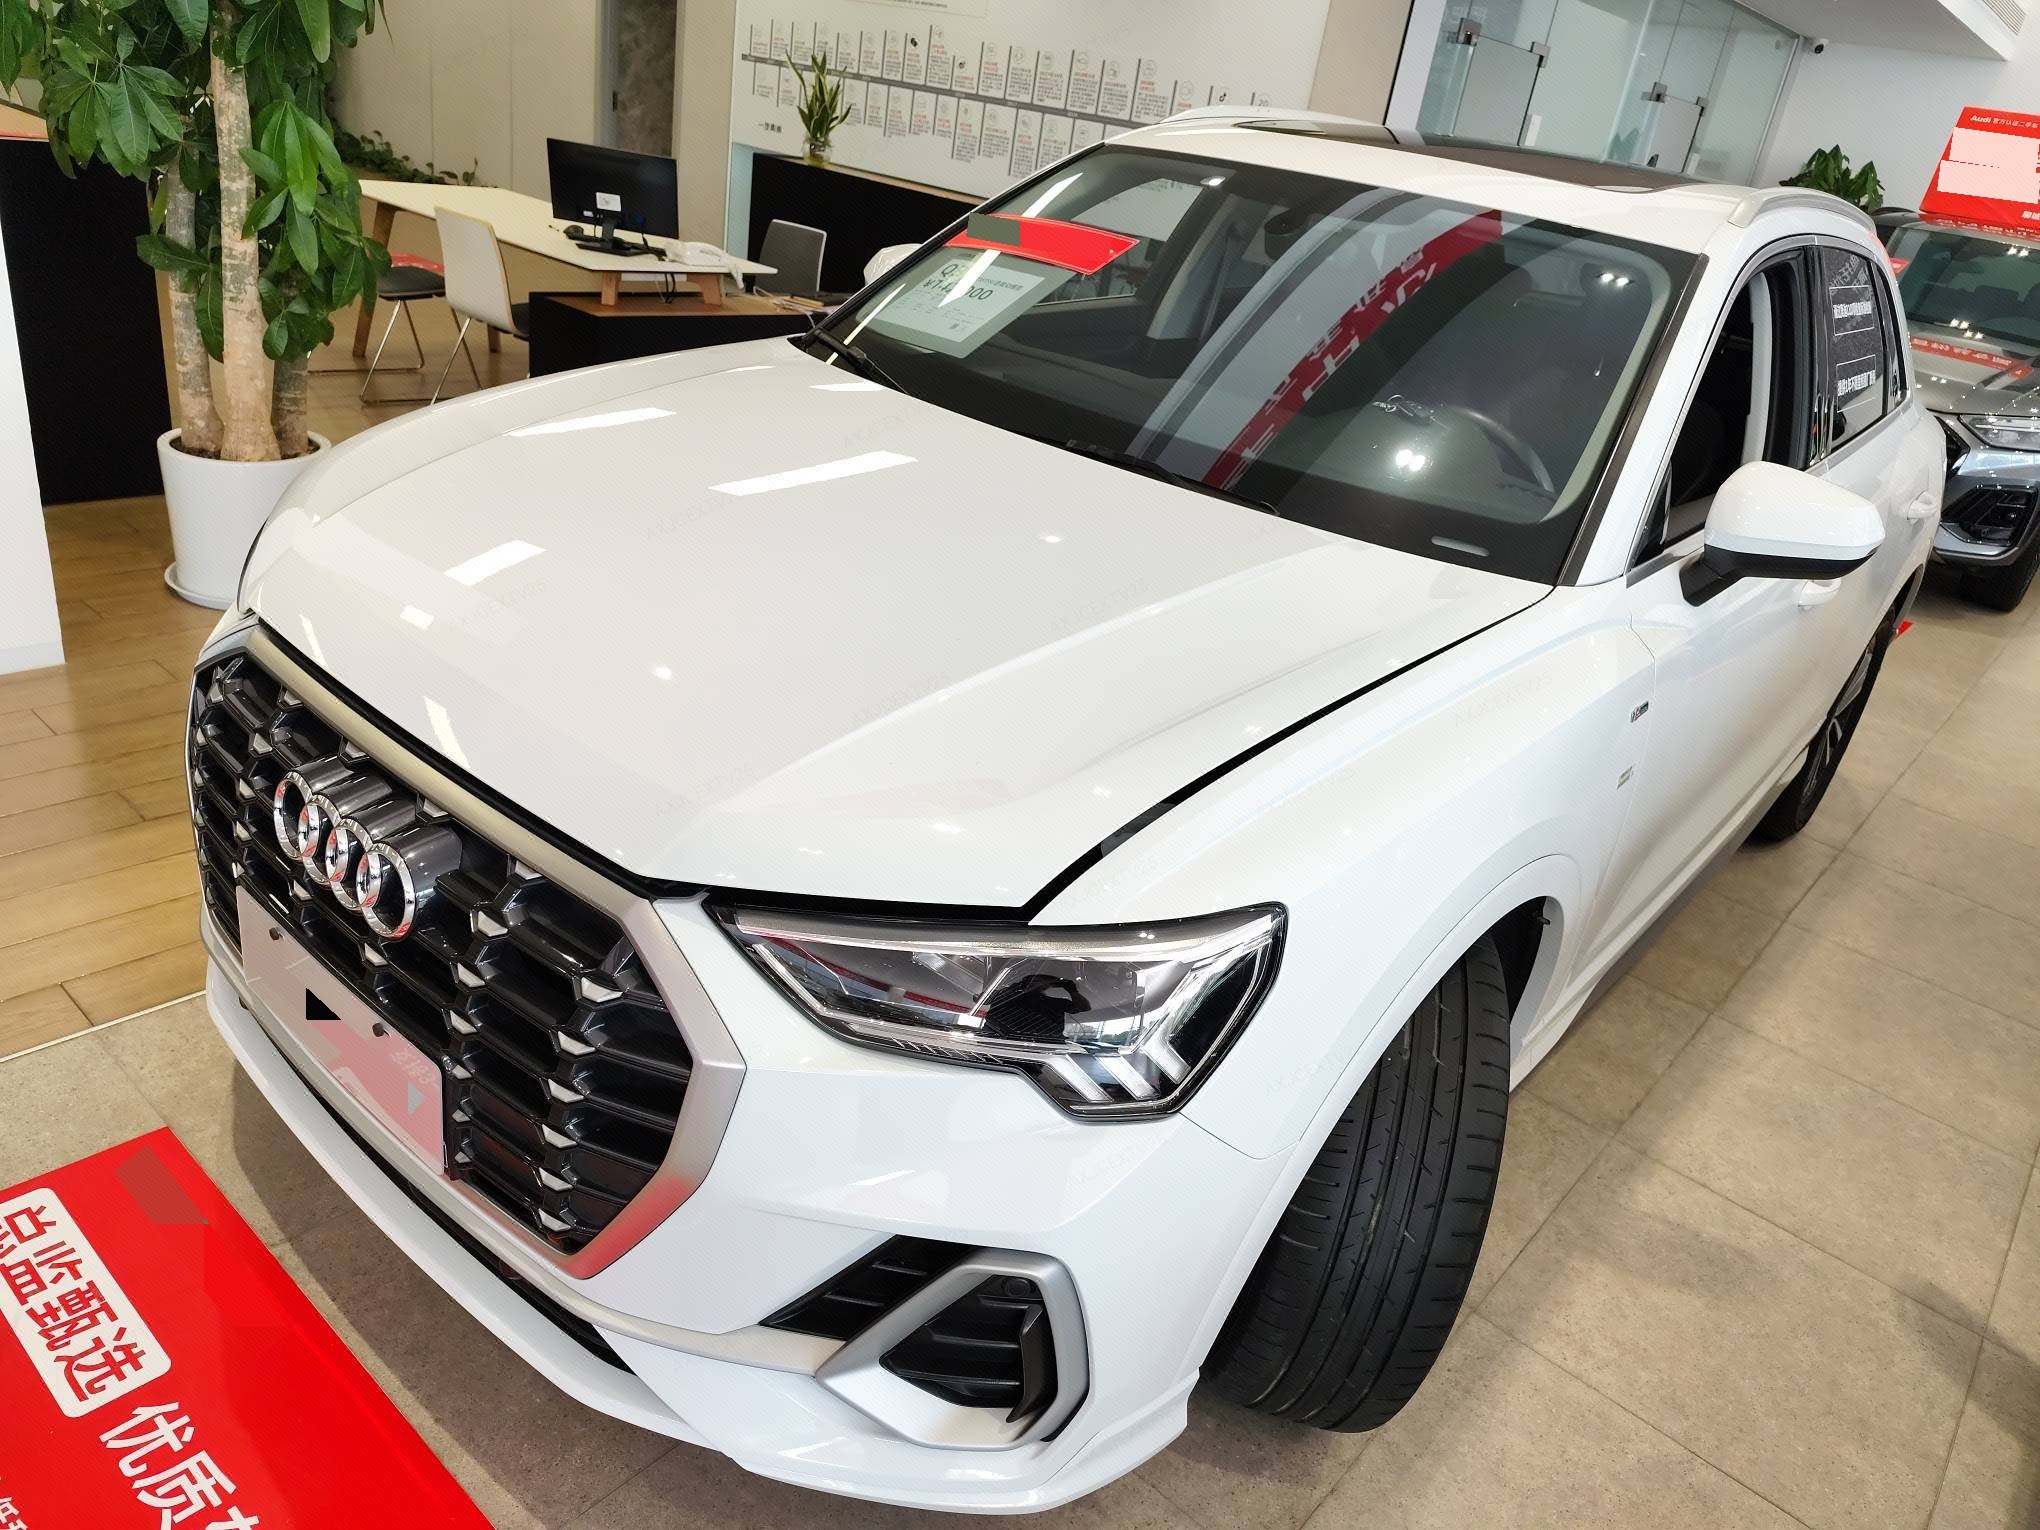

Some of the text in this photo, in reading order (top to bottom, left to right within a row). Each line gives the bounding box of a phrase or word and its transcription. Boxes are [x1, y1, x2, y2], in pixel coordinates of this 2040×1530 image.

[1970, 114, 1991, 123] Audi
[0, 1205, 147, 1402] 总监甄选
